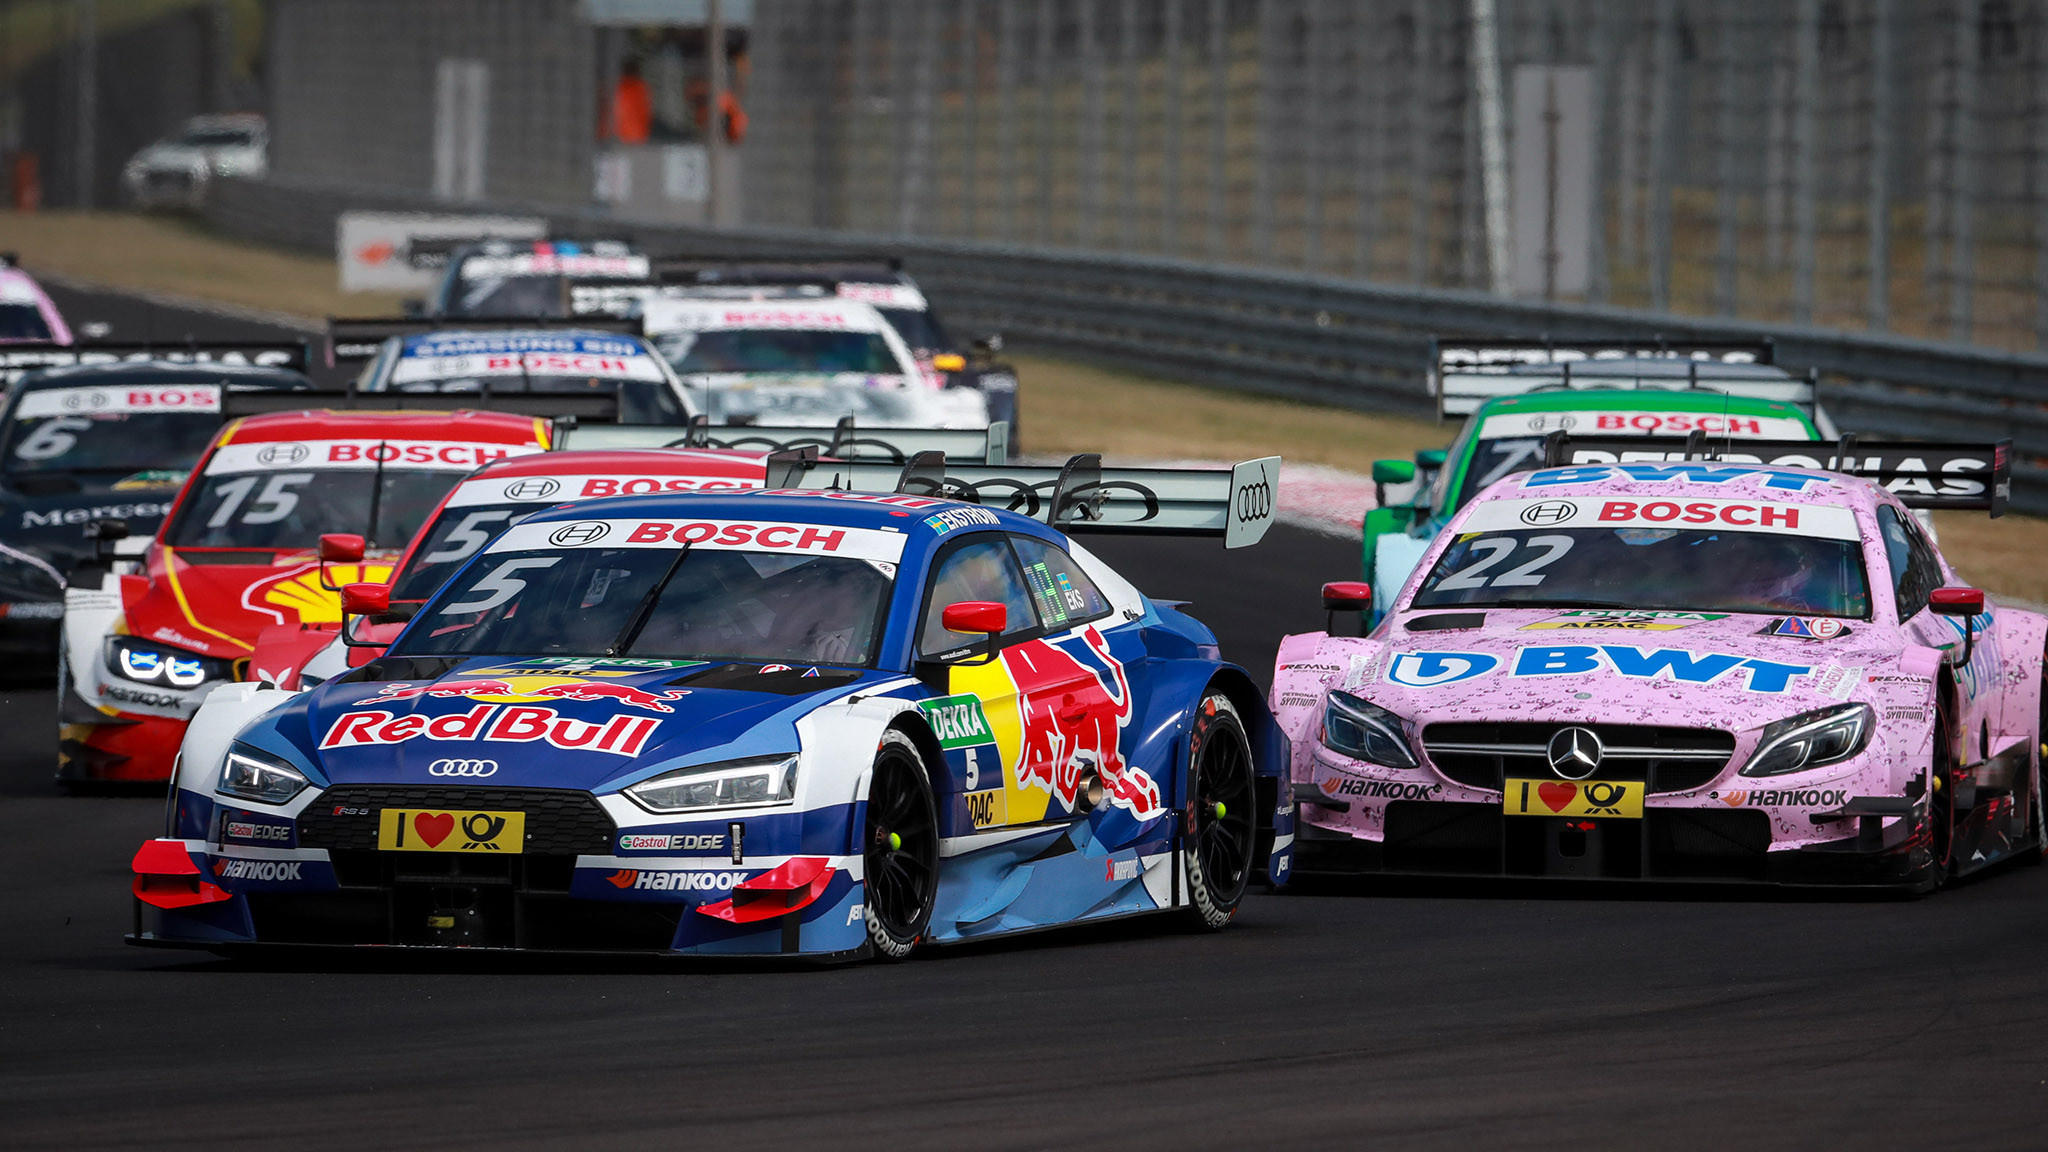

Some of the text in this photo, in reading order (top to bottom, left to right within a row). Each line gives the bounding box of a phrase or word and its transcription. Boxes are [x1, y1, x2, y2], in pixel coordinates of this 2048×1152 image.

[14, 417, 93, 460] 6
[1596, 414, 1762, 435] BOSCH
[328, 444, 508, 465] BOSCH
[1477, 440, 1546, 487] 7
[206, 473, 315, 528] 15
[1597, 501, 1800, 529] BOSCH
[935, 505, 1001, 531] EKSTRÖM
[625, 522, 847, 552] BOSCH
[1433, 535, 1575, 592] 22
[439, 556, 563, 615] 5
[1064, 588, 1086, 611] EKS
[1559, 622, 1649, 630] ADAC
[1578, 611, 1709, 621] DEKRA
[542, 657, 675, 667] DEKRA
[1508, 645, 1819, 694] BWT
[1873, 676, 1933, 684] REMUS
[318, 703, 663, 759] Red Bull
[930, 702, 987, 741] DEKRA
[965, 748, 980, 791] 5
[1520, 782, 1529, 813] I
[253, 825, 292, 841] EDGE
[395, 812, 406, 848] I
[633, 834, 726, 850] Castrol EDGE
[846, 904, 864, 927] ABT
